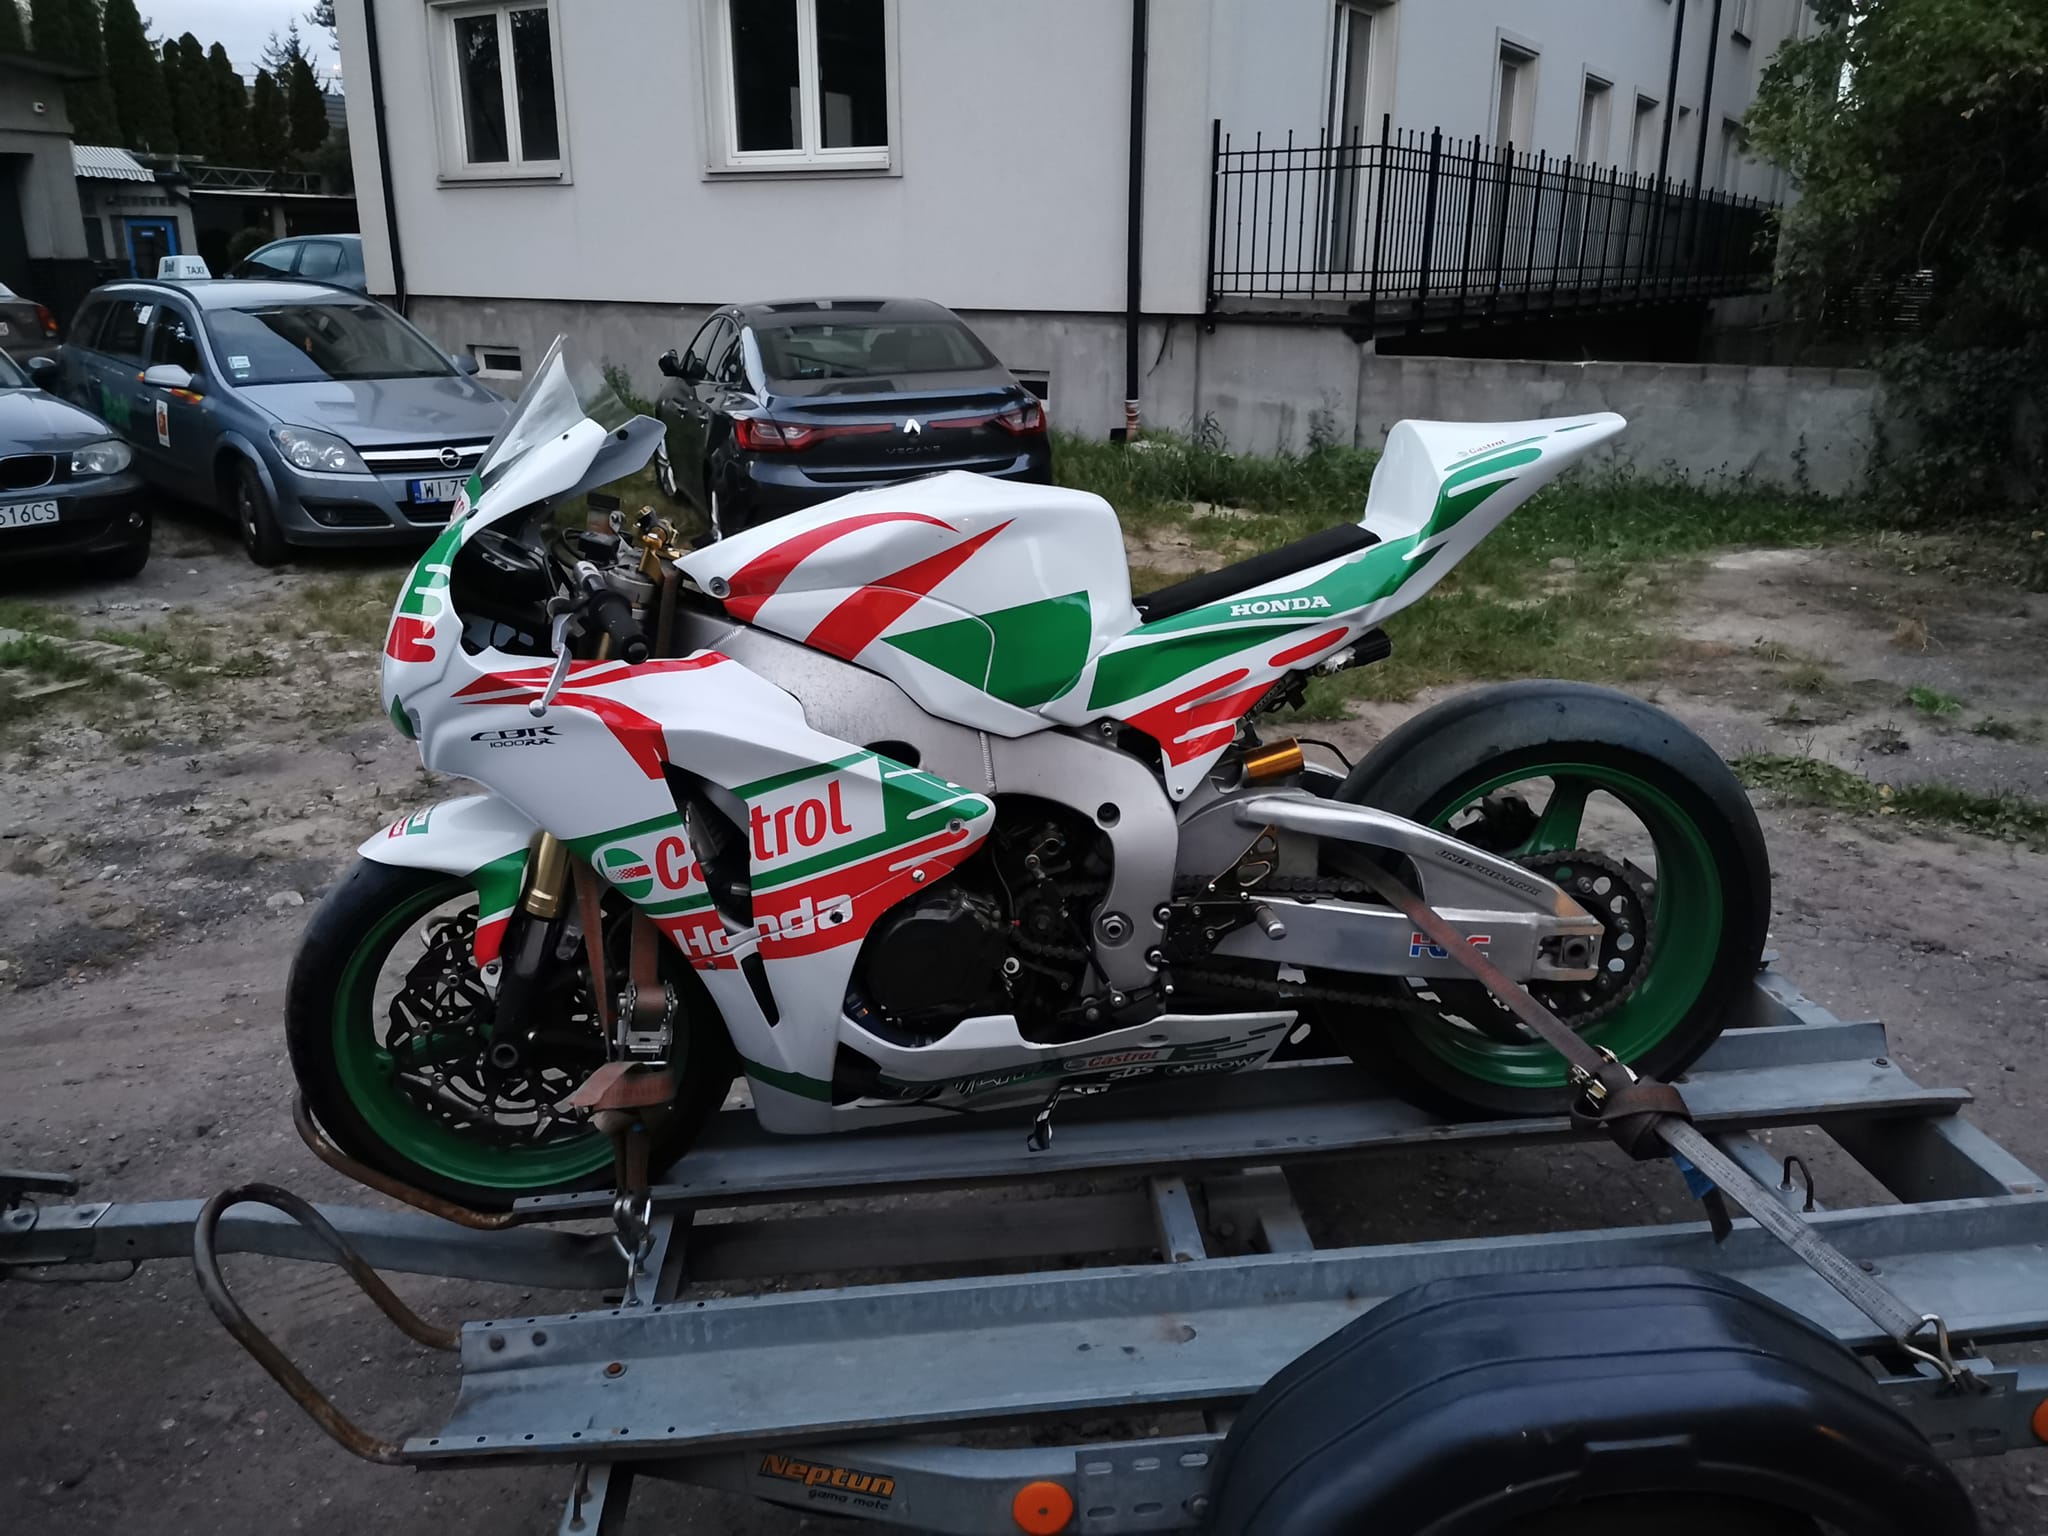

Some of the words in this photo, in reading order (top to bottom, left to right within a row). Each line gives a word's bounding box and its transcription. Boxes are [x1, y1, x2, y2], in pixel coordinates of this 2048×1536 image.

[186, 265, 205, 275] TAXI
[1468, 439, 1505, 454] Castrol
[423, 481, 442, 498] WI
[1230, 596, 1331, 616] HONDA
[470, 726, 562, 741] CBR
[489, 738, 556, 749] 1000RR
[655, 779, 852, 890] Ctrol
[673, 894, 853, 956] Honda
[1088, 1051, 1159, 1067] Castrol
[1174, 1056, 1256, 1074] ARROW
[761, 1454, 896, 1496] Neptun
[808, 1489, 849, 1504] gama
